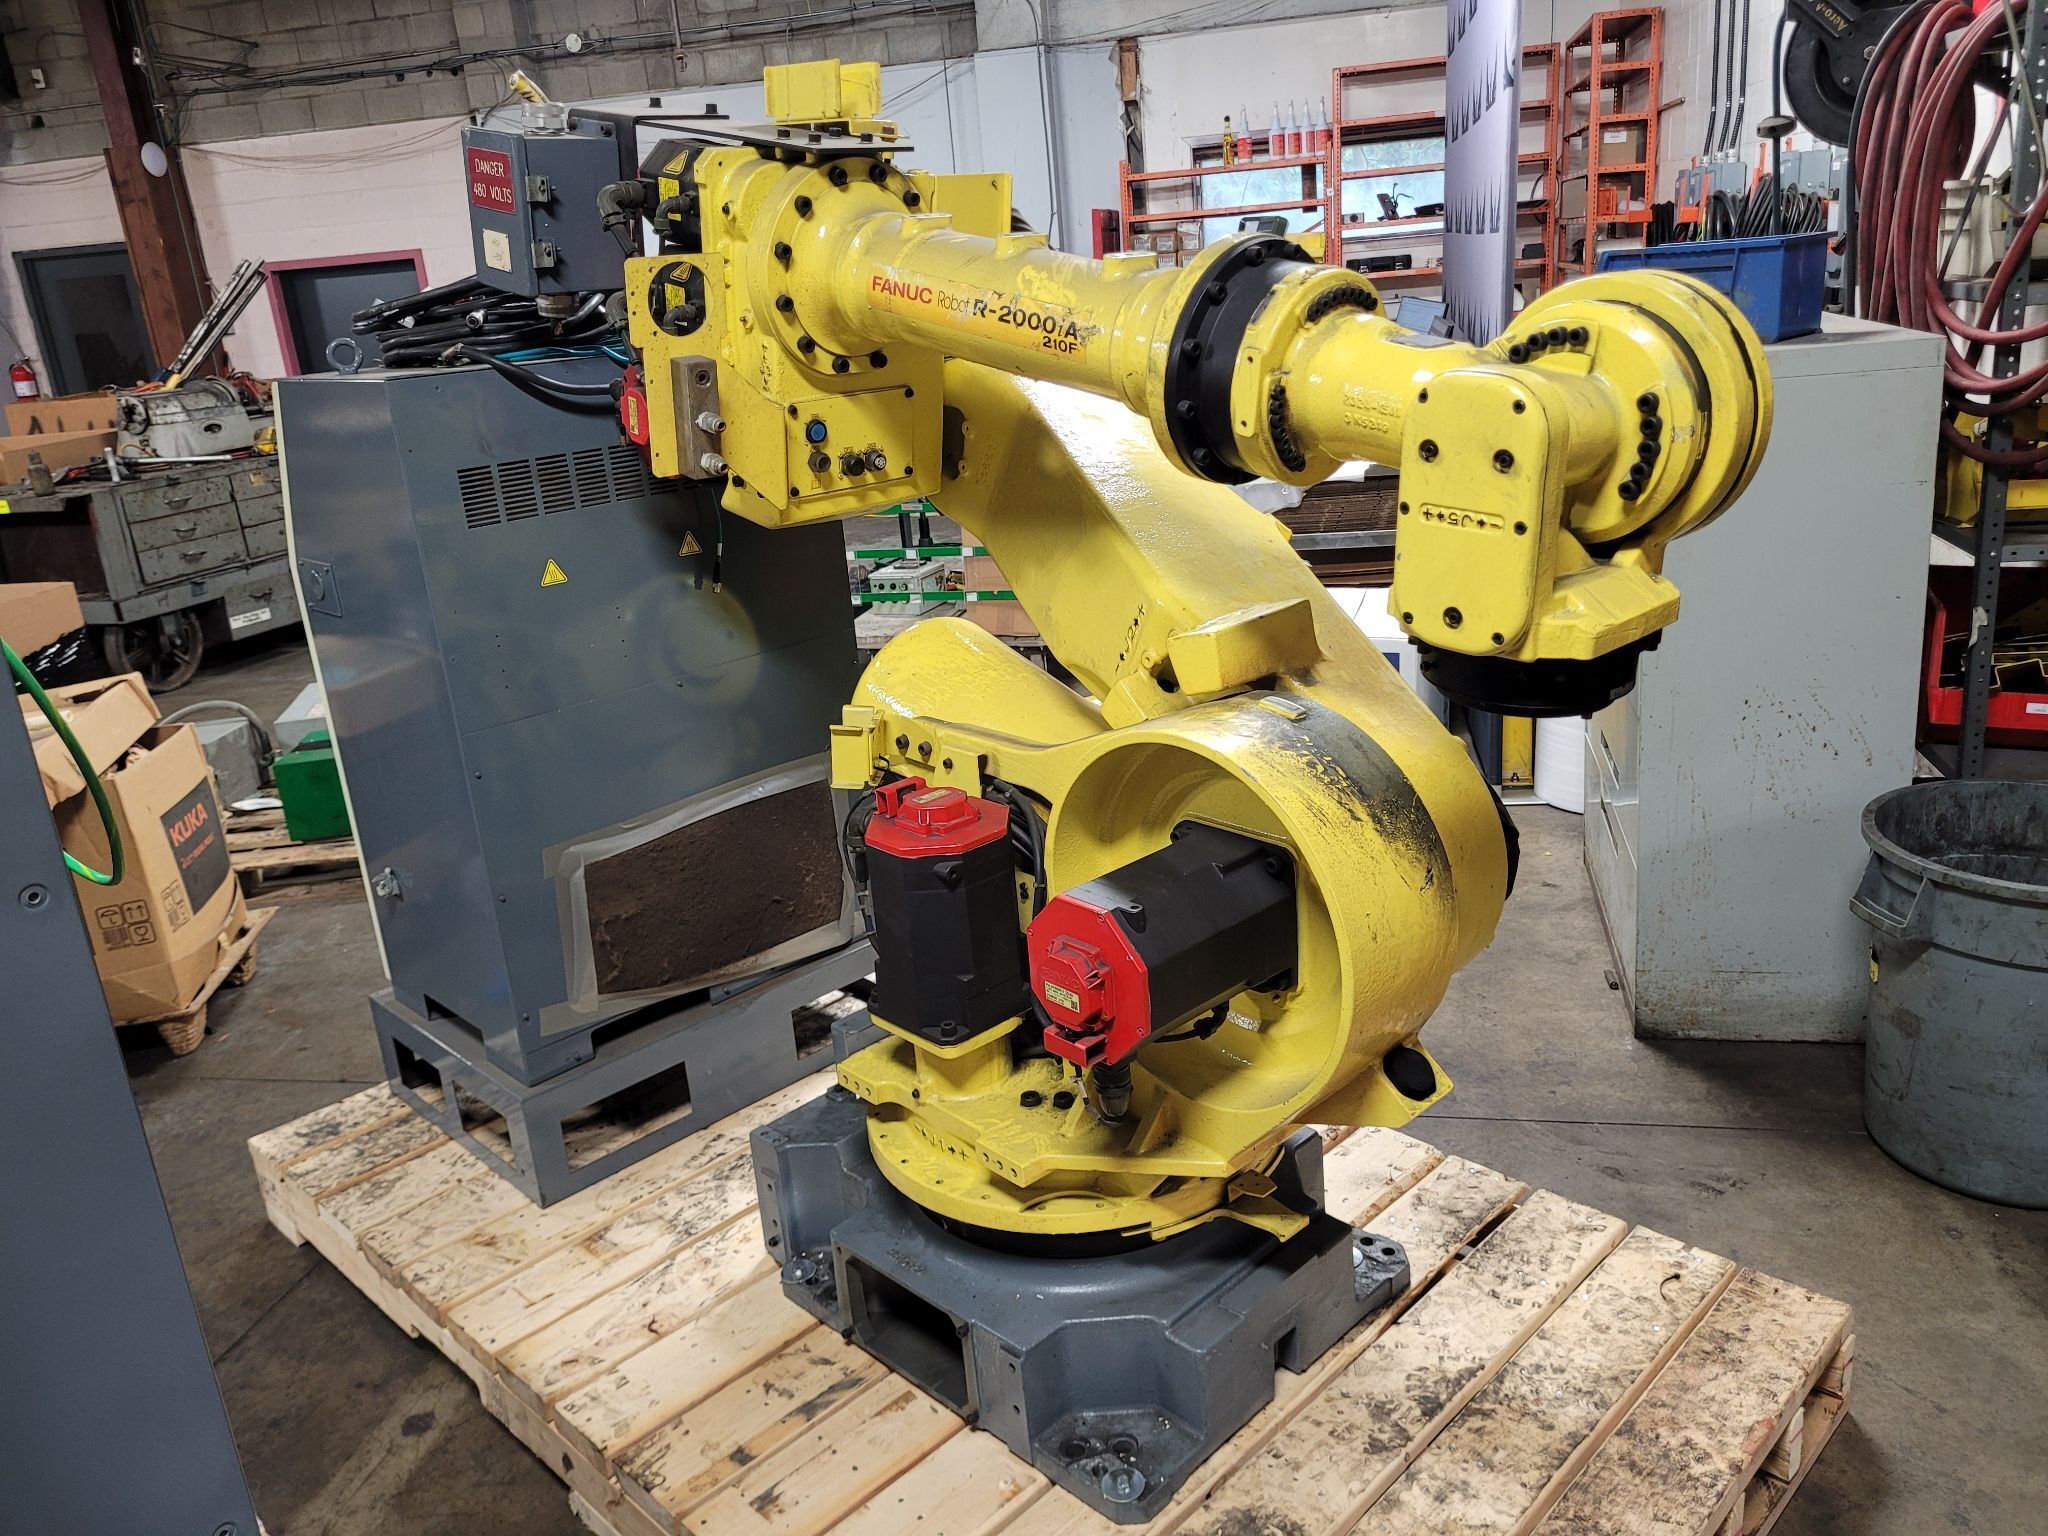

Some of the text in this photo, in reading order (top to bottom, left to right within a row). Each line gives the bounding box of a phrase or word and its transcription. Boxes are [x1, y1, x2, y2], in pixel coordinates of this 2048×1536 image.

[475, 158, 504, 178] DANGER
[473, 182, 512, 203] 480 VOLTS
[872, 275, 932, 304] FANUC
[937, 290, 970, 314] Robot
[1042, 335, 1078, 354] 210F
[169, 802, 209, 847] KUKA
